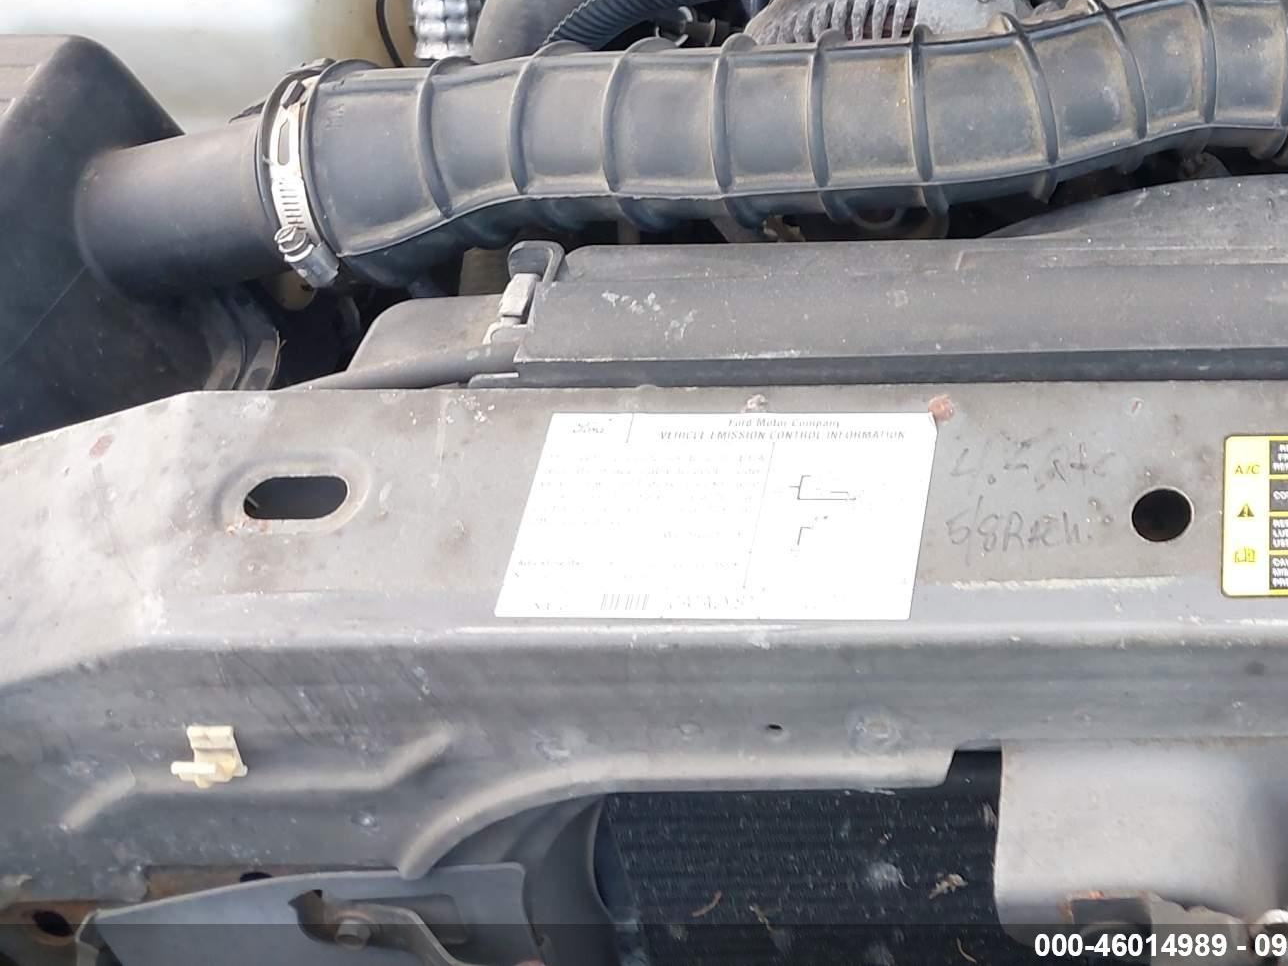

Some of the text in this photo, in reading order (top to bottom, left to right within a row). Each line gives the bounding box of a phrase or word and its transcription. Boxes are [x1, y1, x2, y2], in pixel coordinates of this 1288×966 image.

[791, 418, 840, 428] Company
[709, 431, 766, 440] EMISSION
[768, 431, 820, 440] CONTROL
[825, 431, 905, 440] INFORMATION
[1235, 464, 1260, 475] A/C
